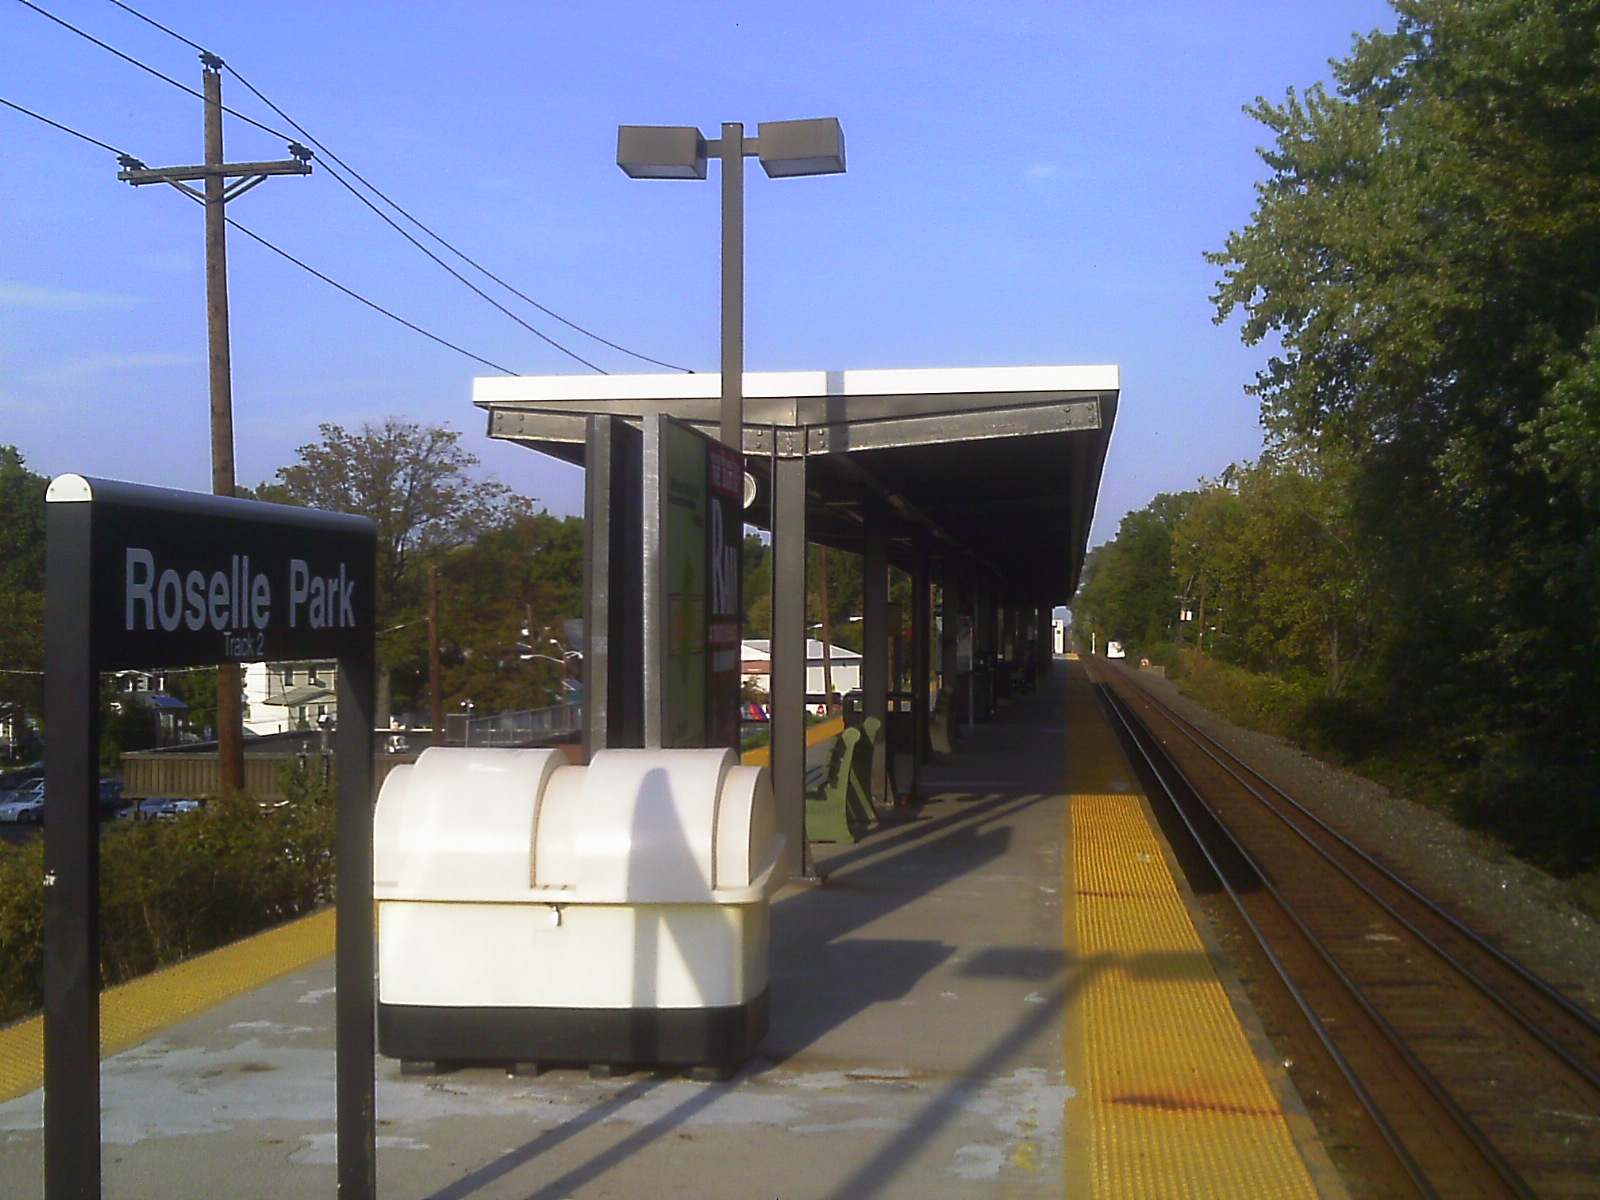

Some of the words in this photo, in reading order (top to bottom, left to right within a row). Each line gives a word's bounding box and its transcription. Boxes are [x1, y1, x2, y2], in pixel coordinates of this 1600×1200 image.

[125, 547, 271, 632] Roselle
[289, 558, 356, 628] Park
[224, 631, 253, 657] Track
[257, 632, 264, 656] 2
